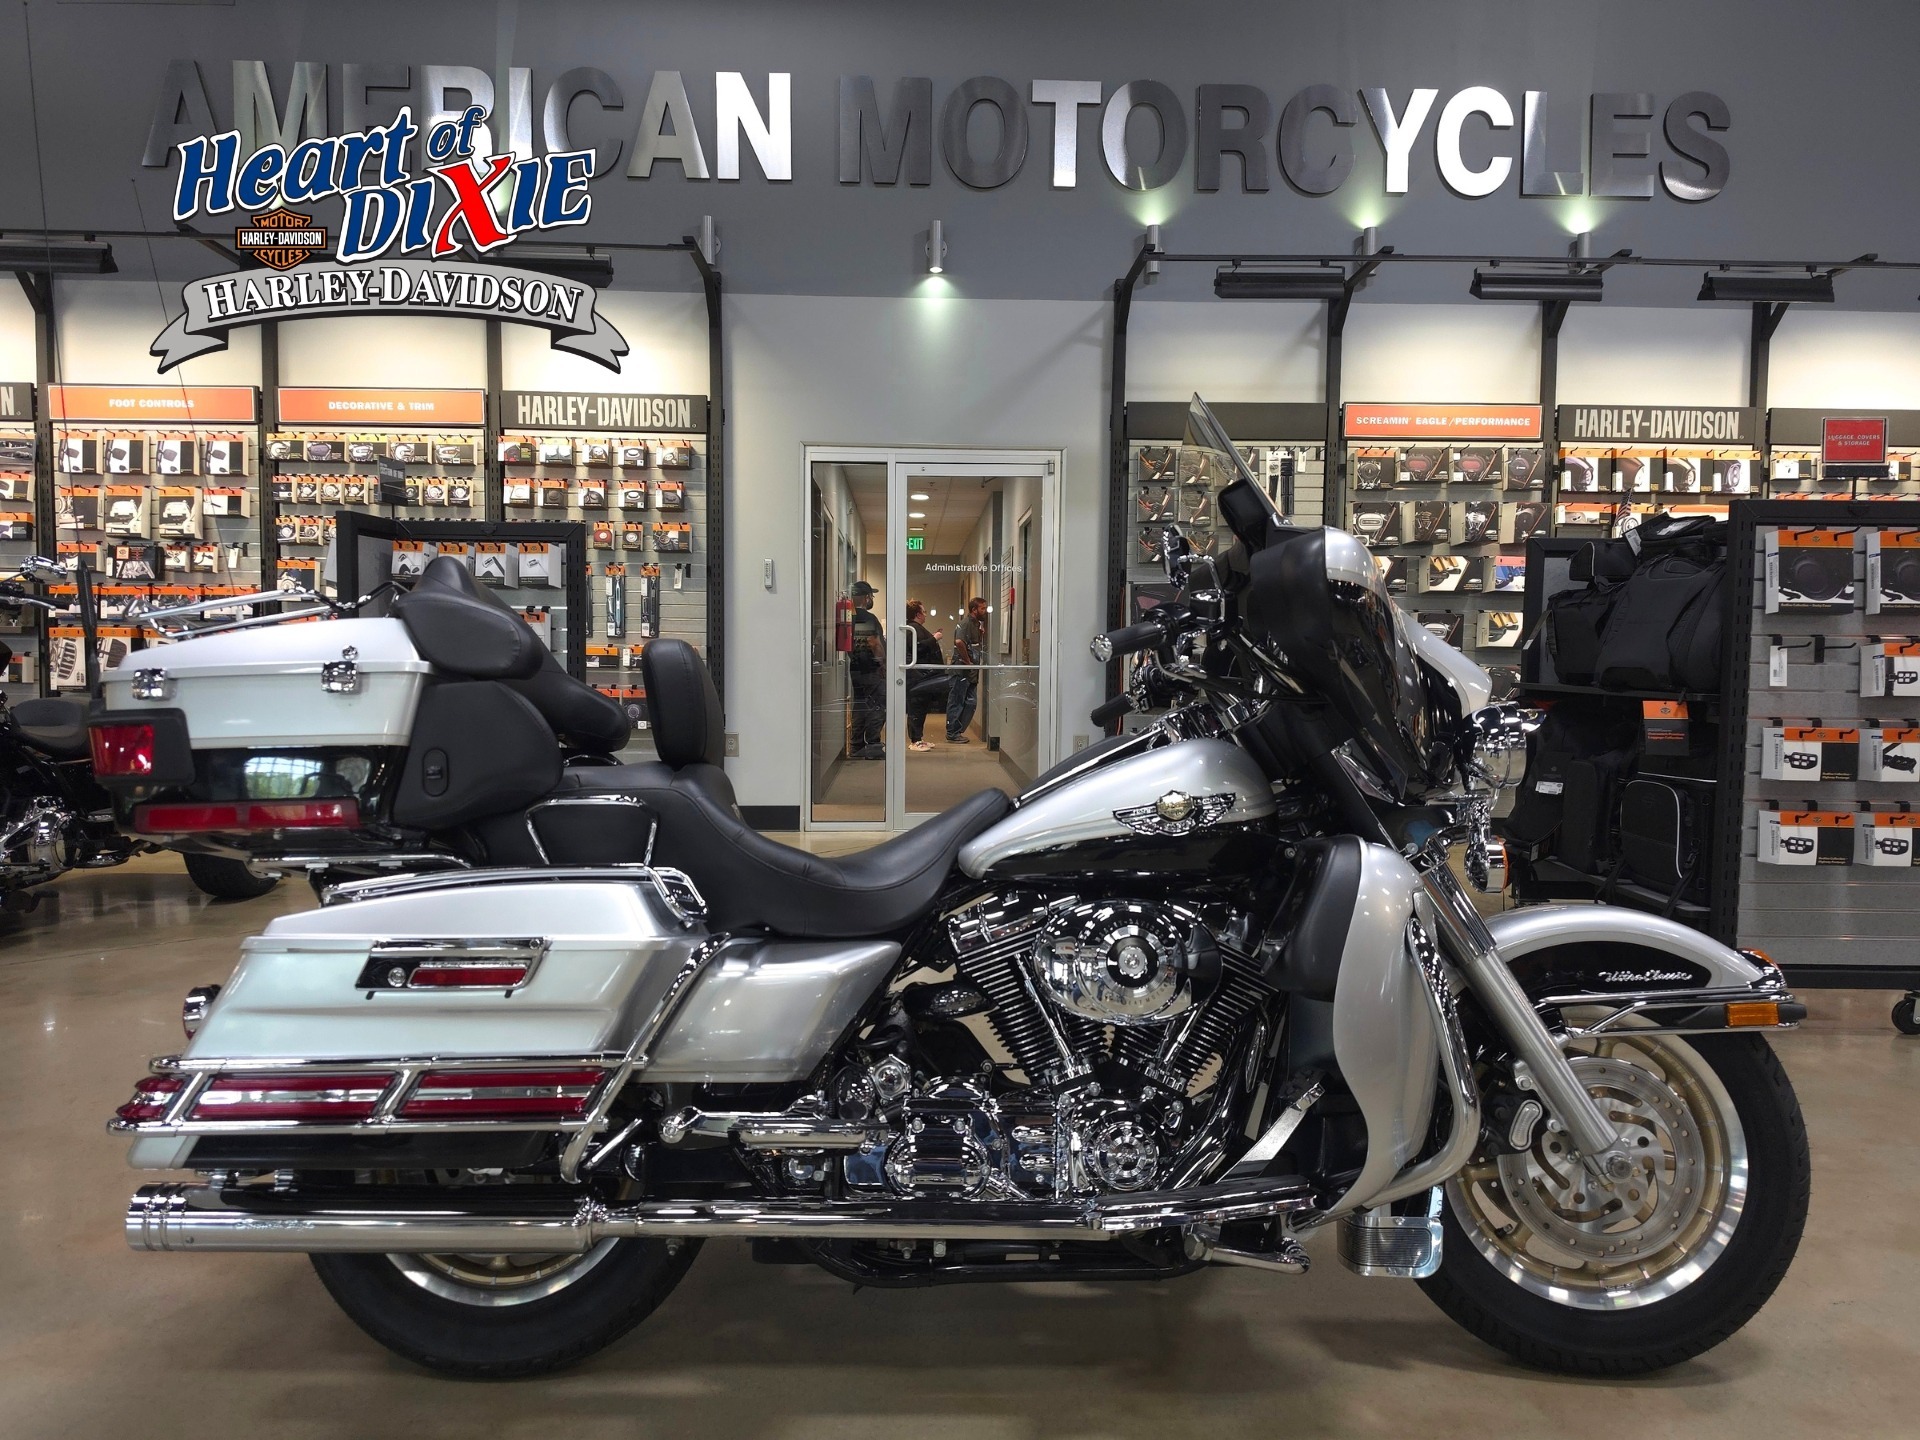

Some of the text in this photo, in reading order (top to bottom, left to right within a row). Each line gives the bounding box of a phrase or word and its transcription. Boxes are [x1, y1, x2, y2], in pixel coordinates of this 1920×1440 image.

[142, 59, 1731, 203] AMERICAN MOTORCYCLES
[109, 398, 195, 409] FOOT CONTROLS
[328, 401, 435, 411] DECORATIVE & TRIM
[517, 394, 691, 428] HARLEY-DAVIDSON
[1574, 408, 1740, 440] HARLEY-DAVIDSON
[908, 537, 924, 550] EXIT
[925, 562, 988, 573] Administrative
